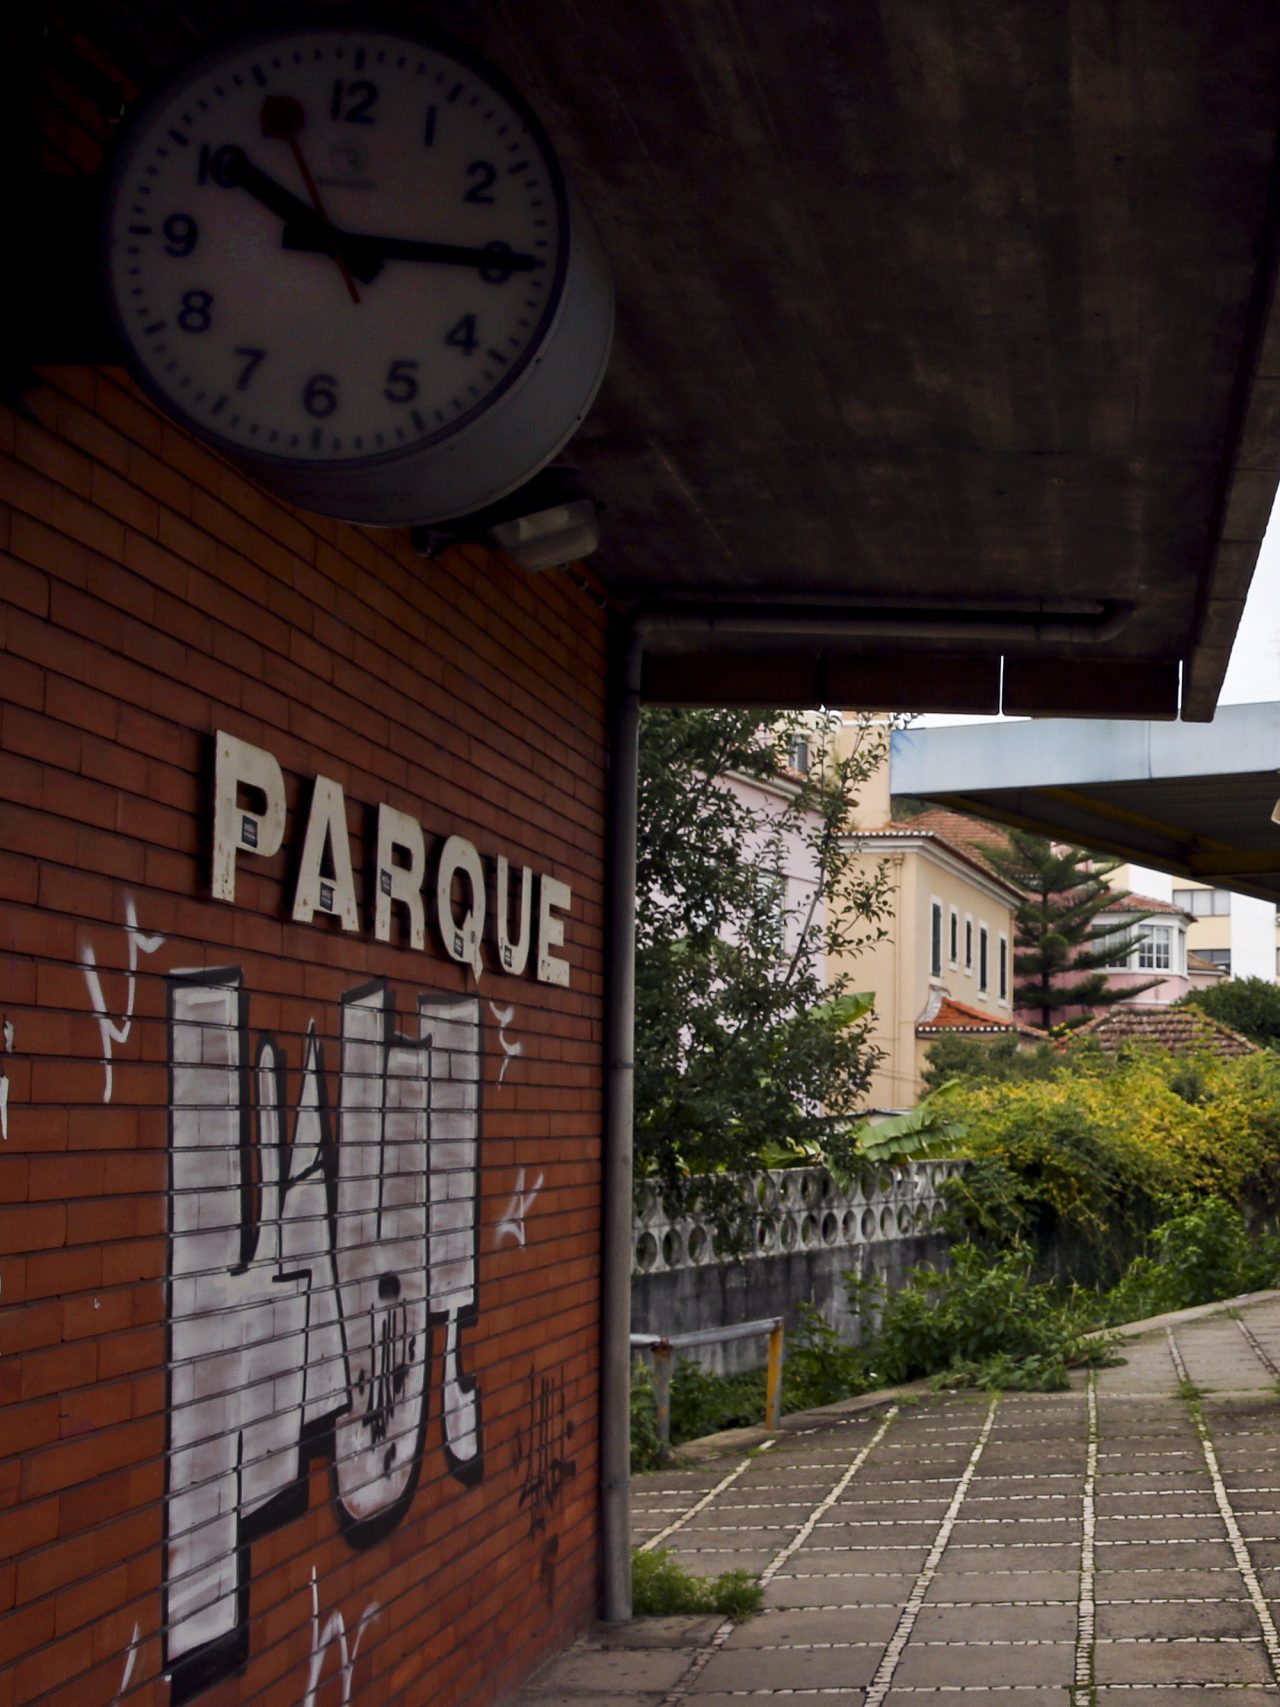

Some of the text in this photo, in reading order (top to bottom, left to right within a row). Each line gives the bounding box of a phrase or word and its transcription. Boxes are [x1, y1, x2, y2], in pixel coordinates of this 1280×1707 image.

[330, 79, 378, 124] 12
[423, 105, 437, 147] 1
[198, 144, 247, 188] 10
[464, 161, 496, 204] 2
[163, 213, 199, 257] 9
[177, 290, 213, 333] 8
[444, 313, 479, 356] 4
[234, 347, 267, 391] 7
[383, 360, 420, 404] 5
[303, 374, 338, 418] 6
[210, 728, 572, 988] PARQUE
